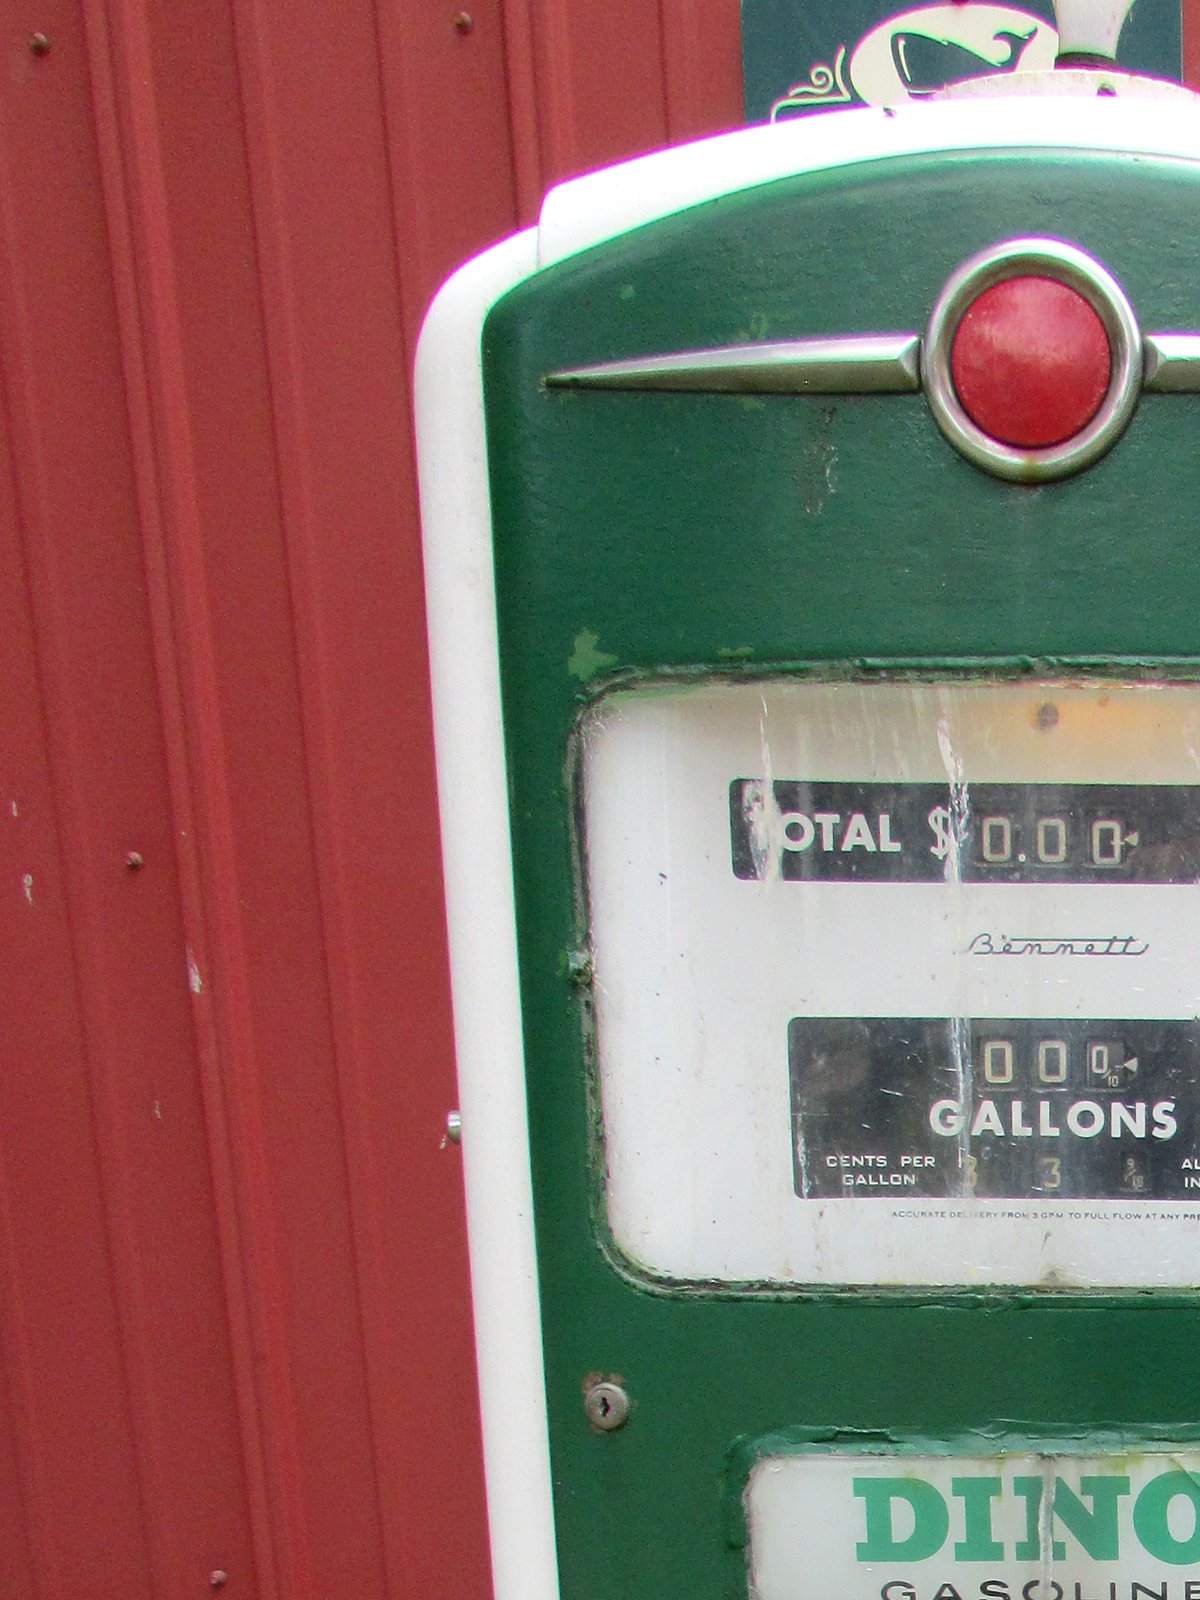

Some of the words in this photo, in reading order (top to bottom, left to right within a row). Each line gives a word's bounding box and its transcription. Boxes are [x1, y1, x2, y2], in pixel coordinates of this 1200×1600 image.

[968, 933, 1150, 956] Bennett
[928, 1099, 1178, 1139] GALLONS
[826, 1155, 888, 1167] CENTS
[901, 1156, 936, 1167] PER
[842, 1174, 916, 1186] GALLON
[891, 1210, 947, 1219] ACCURATE
[1001, 1211, 1030, 1219] FROM
[1040, 1211, 1063, 1219] GPM
[1068, 1211, 1081, 1219] TO
[1084, 1211, 1110, 1220] FULL
[1112, 1211, 1142, 1220] FLOW
[1144, 1212, 1157, 1220] AT
[1160, 1212, 1180, 1220] ANY
